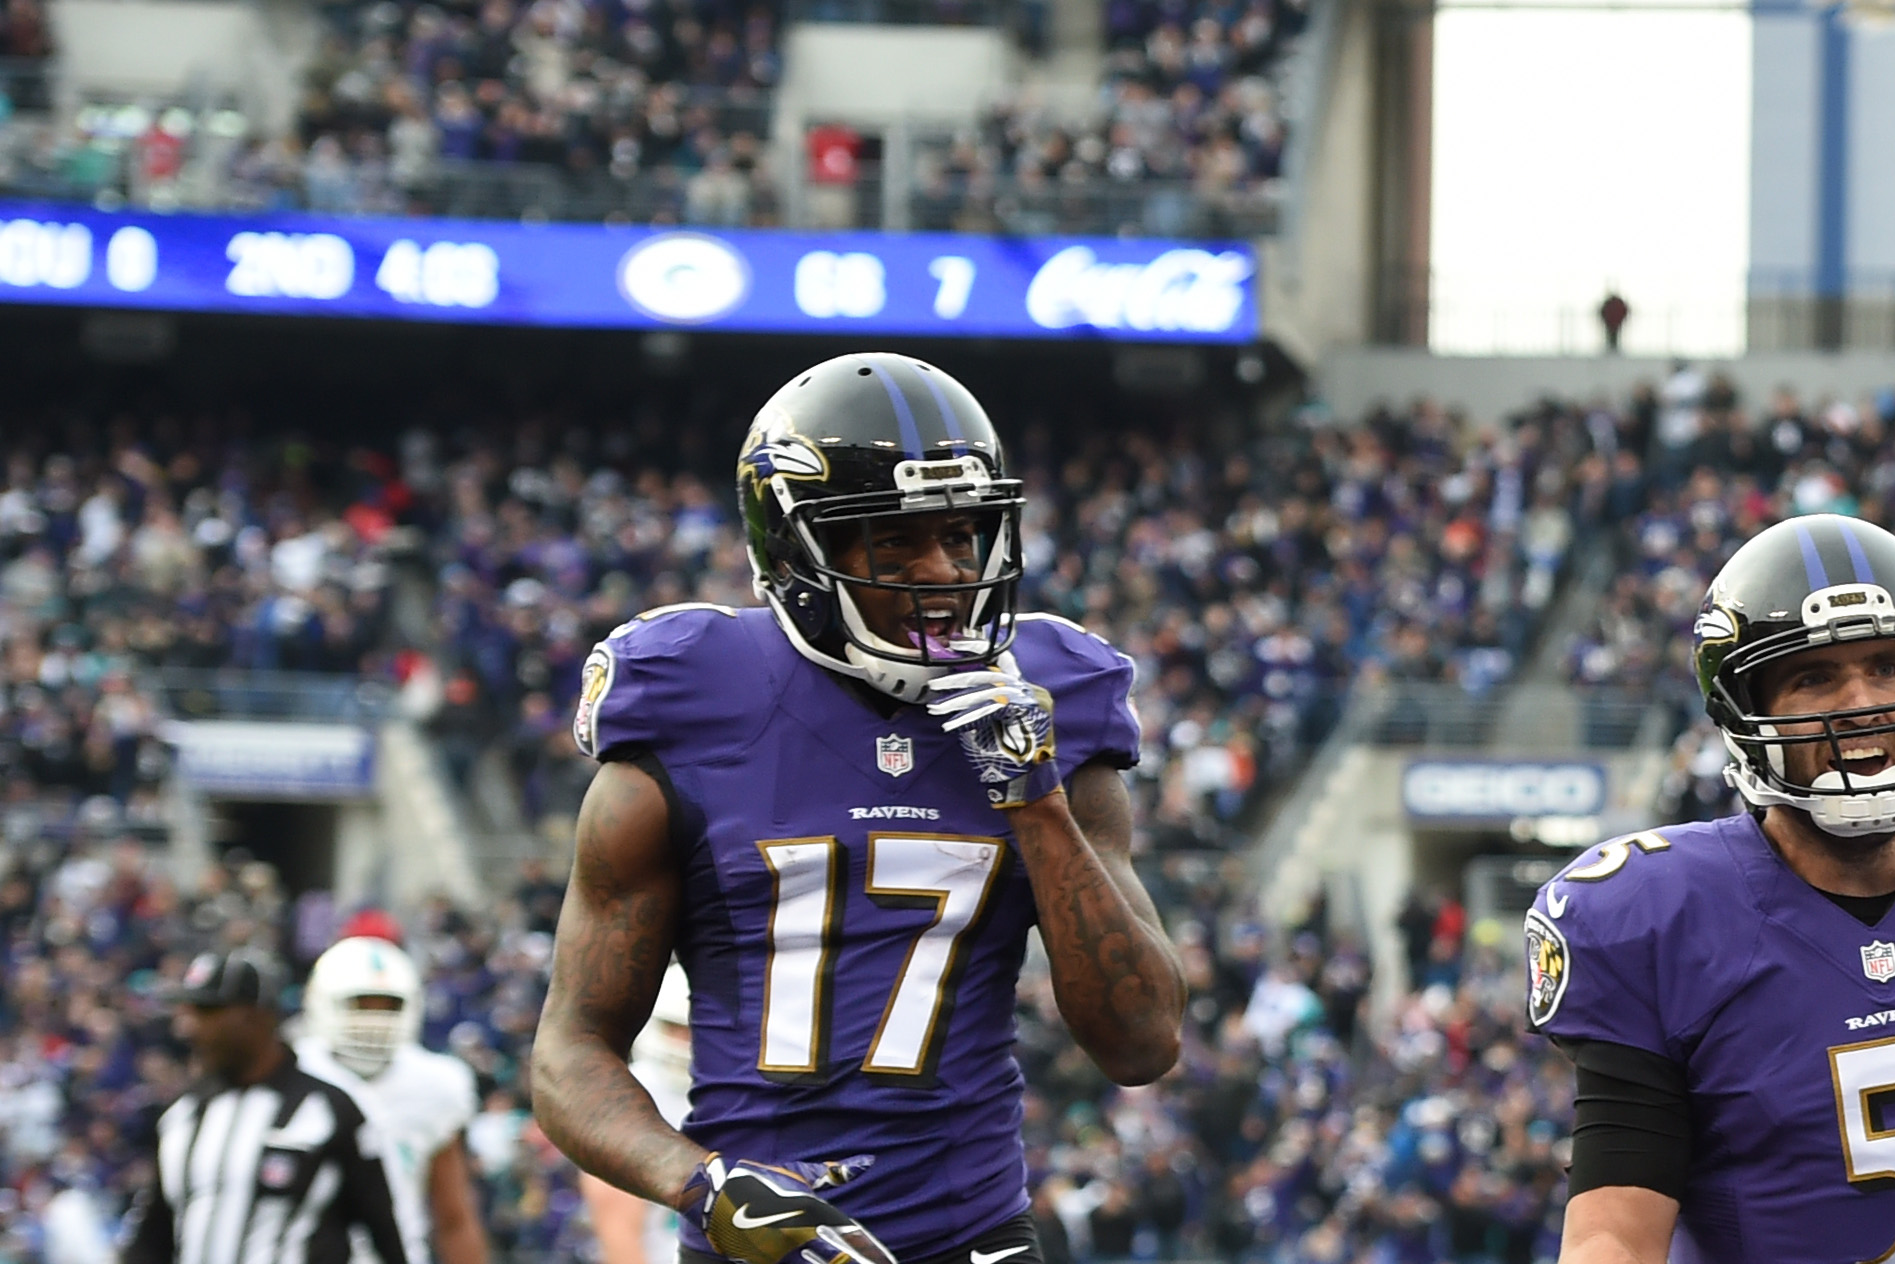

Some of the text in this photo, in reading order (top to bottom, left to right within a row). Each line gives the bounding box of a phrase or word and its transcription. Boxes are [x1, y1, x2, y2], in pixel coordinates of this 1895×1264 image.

[928, 255, 975, 320] 7
[884, 753, 907, 769] NFL
[1405, 763, 1598, 815] GEICO
[848, 806, 940, 820] RAVENS
[756, 832, 1000, 1076] 17
[1868, 958, 1894, 975] NFL
